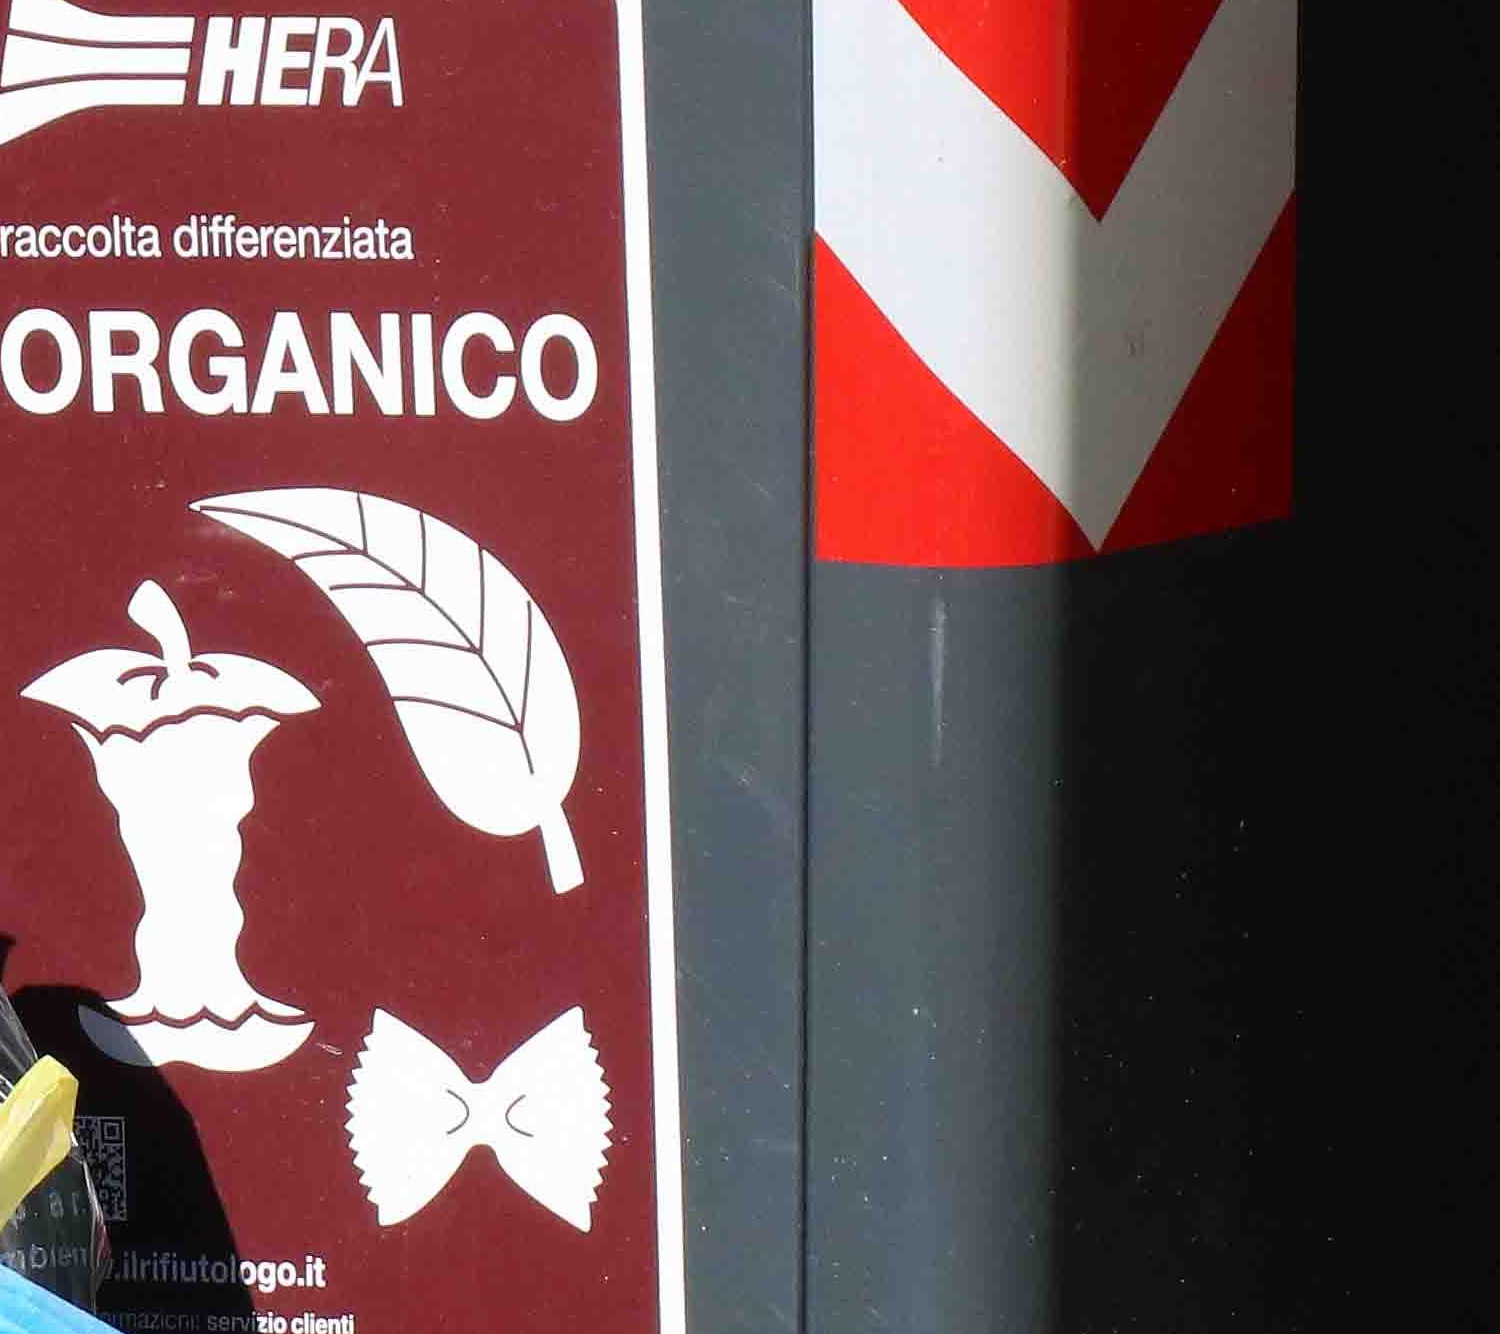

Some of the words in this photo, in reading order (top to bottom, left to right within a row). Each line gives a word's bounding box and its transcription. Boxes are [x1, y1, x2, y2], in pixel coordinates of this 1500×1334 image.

[198, 16, 403, 106] HERA
[0, 216, 161, 258] raccolta
[174, 216, 414, 260] differenziata
[0, 308, 598, 421] ORGANICO
[207, 1312, 287, 1334] servizio
